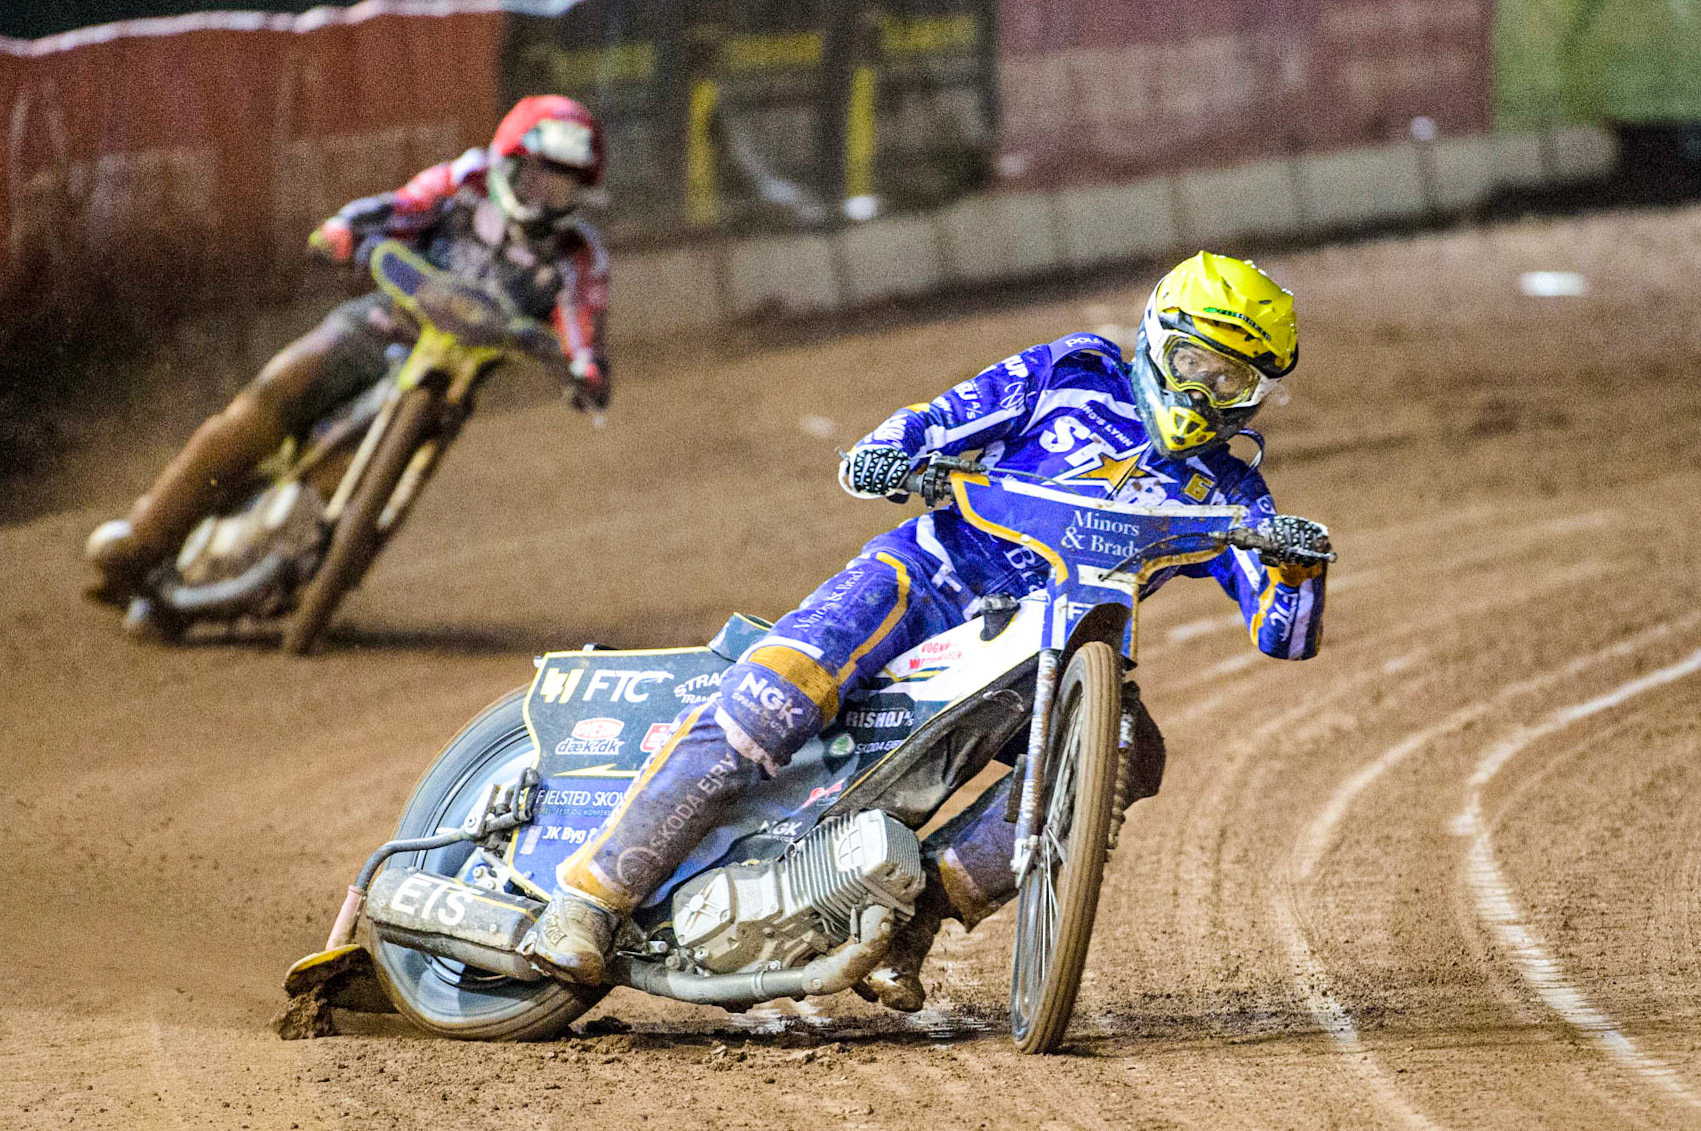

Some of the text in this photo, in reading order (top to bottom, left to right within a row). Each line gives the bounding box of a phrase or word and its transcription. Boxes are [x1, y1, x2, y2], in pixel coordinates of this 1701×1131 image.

[1104, 424, 1134, 447] LYNN
[1070, 510, 1140, 537] Minors
[1061, 526, 1086, 550] &
[583, 669, 674, 703] FTC
[737, 671, 804, 729] NGK
[535, 789, 592, 806] FJELSTED
[561, 826, 587, 844] Byg
